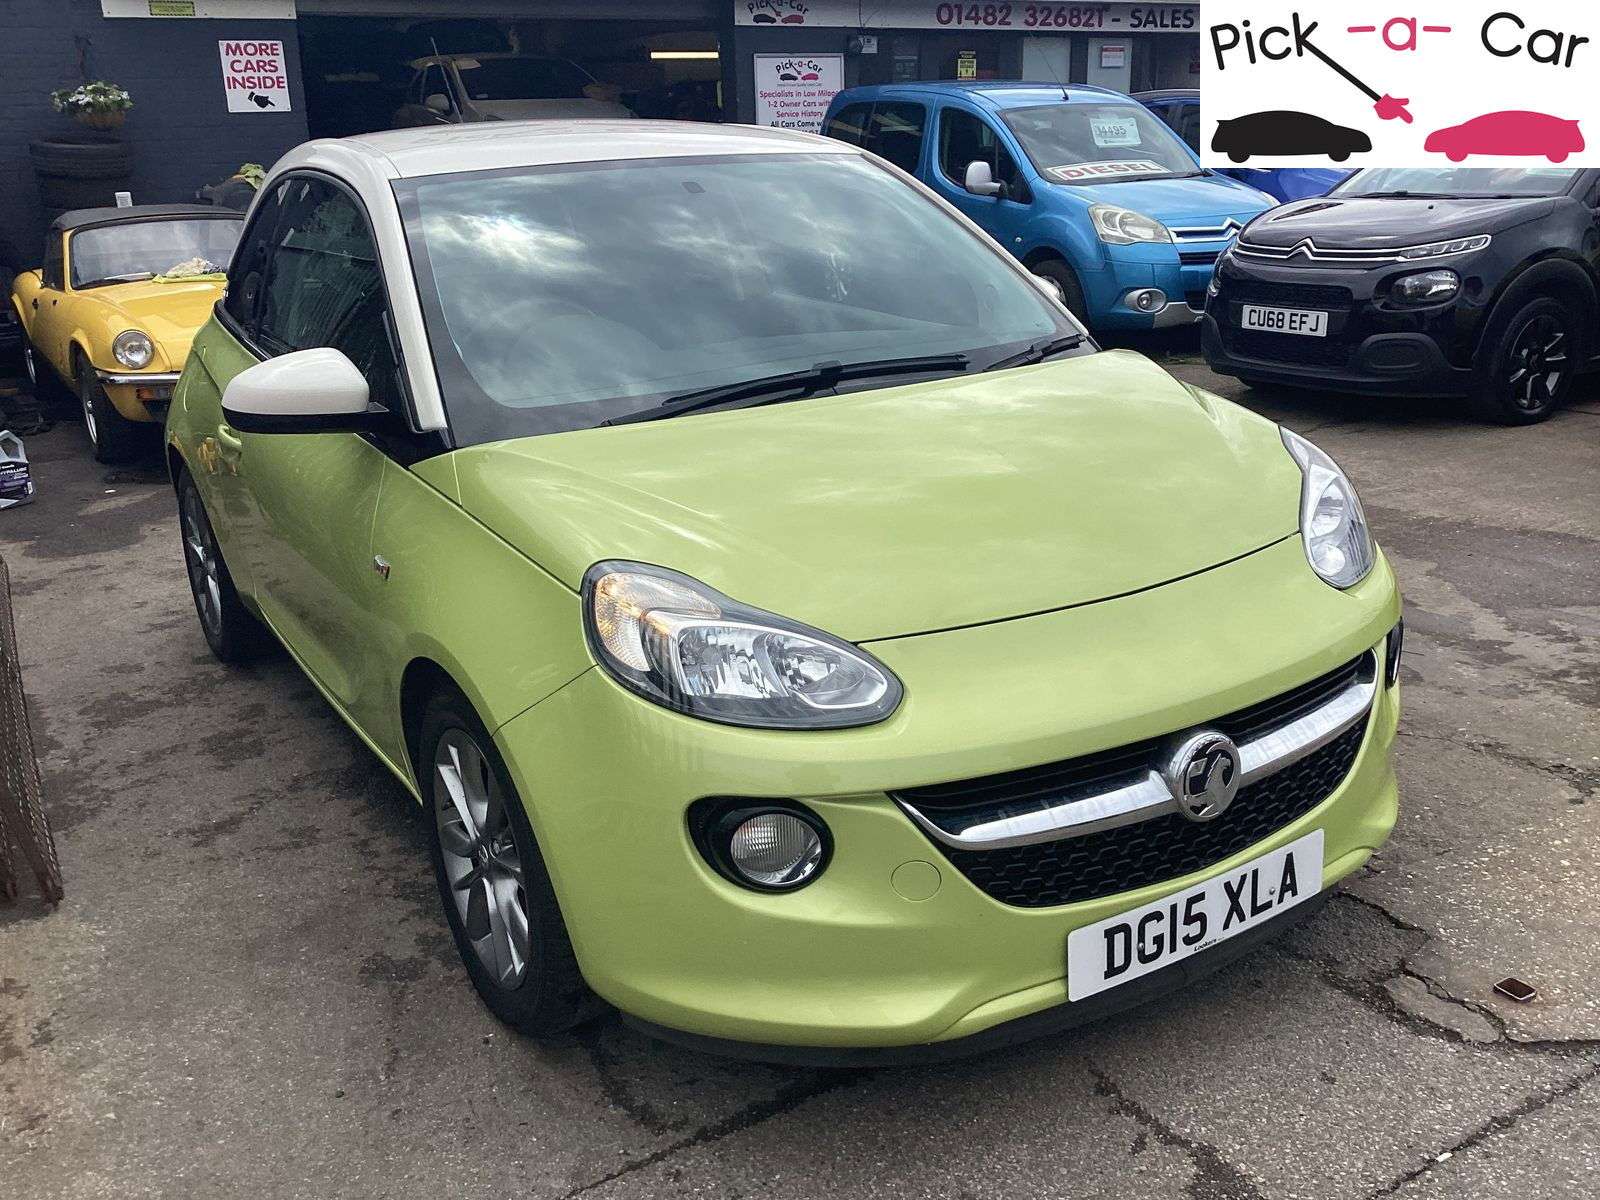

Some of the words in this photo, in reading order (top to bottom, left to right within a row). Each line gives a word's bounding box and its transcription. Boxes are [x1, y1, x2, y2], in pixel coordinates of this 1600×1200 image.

[936, 3, 1012, 25] 01482
[1130, 8, 1194, 28] SALES
[225, 42, 280, 57] MORE
[230, 59, 278, 73] CARS
[226, 76, 286, 90] INSIDE
[759, 90, 794, 99] Specialists
[780, 100, 801, 108] Owner
[802, 100, 817, 108] Cars
[776, 110, 799, 118] Service
[801, 110, 824, 118] History
[781, 120, 796, 128] Cars
[797, 120, 815, 128] Come
[1062, 163, 1162, 178] DIESEL
[1248, 309, 1285, 329] CU68
[1289, 312, 1320, 332] EFJ
[1222, 851, 1299, 931] XLA
